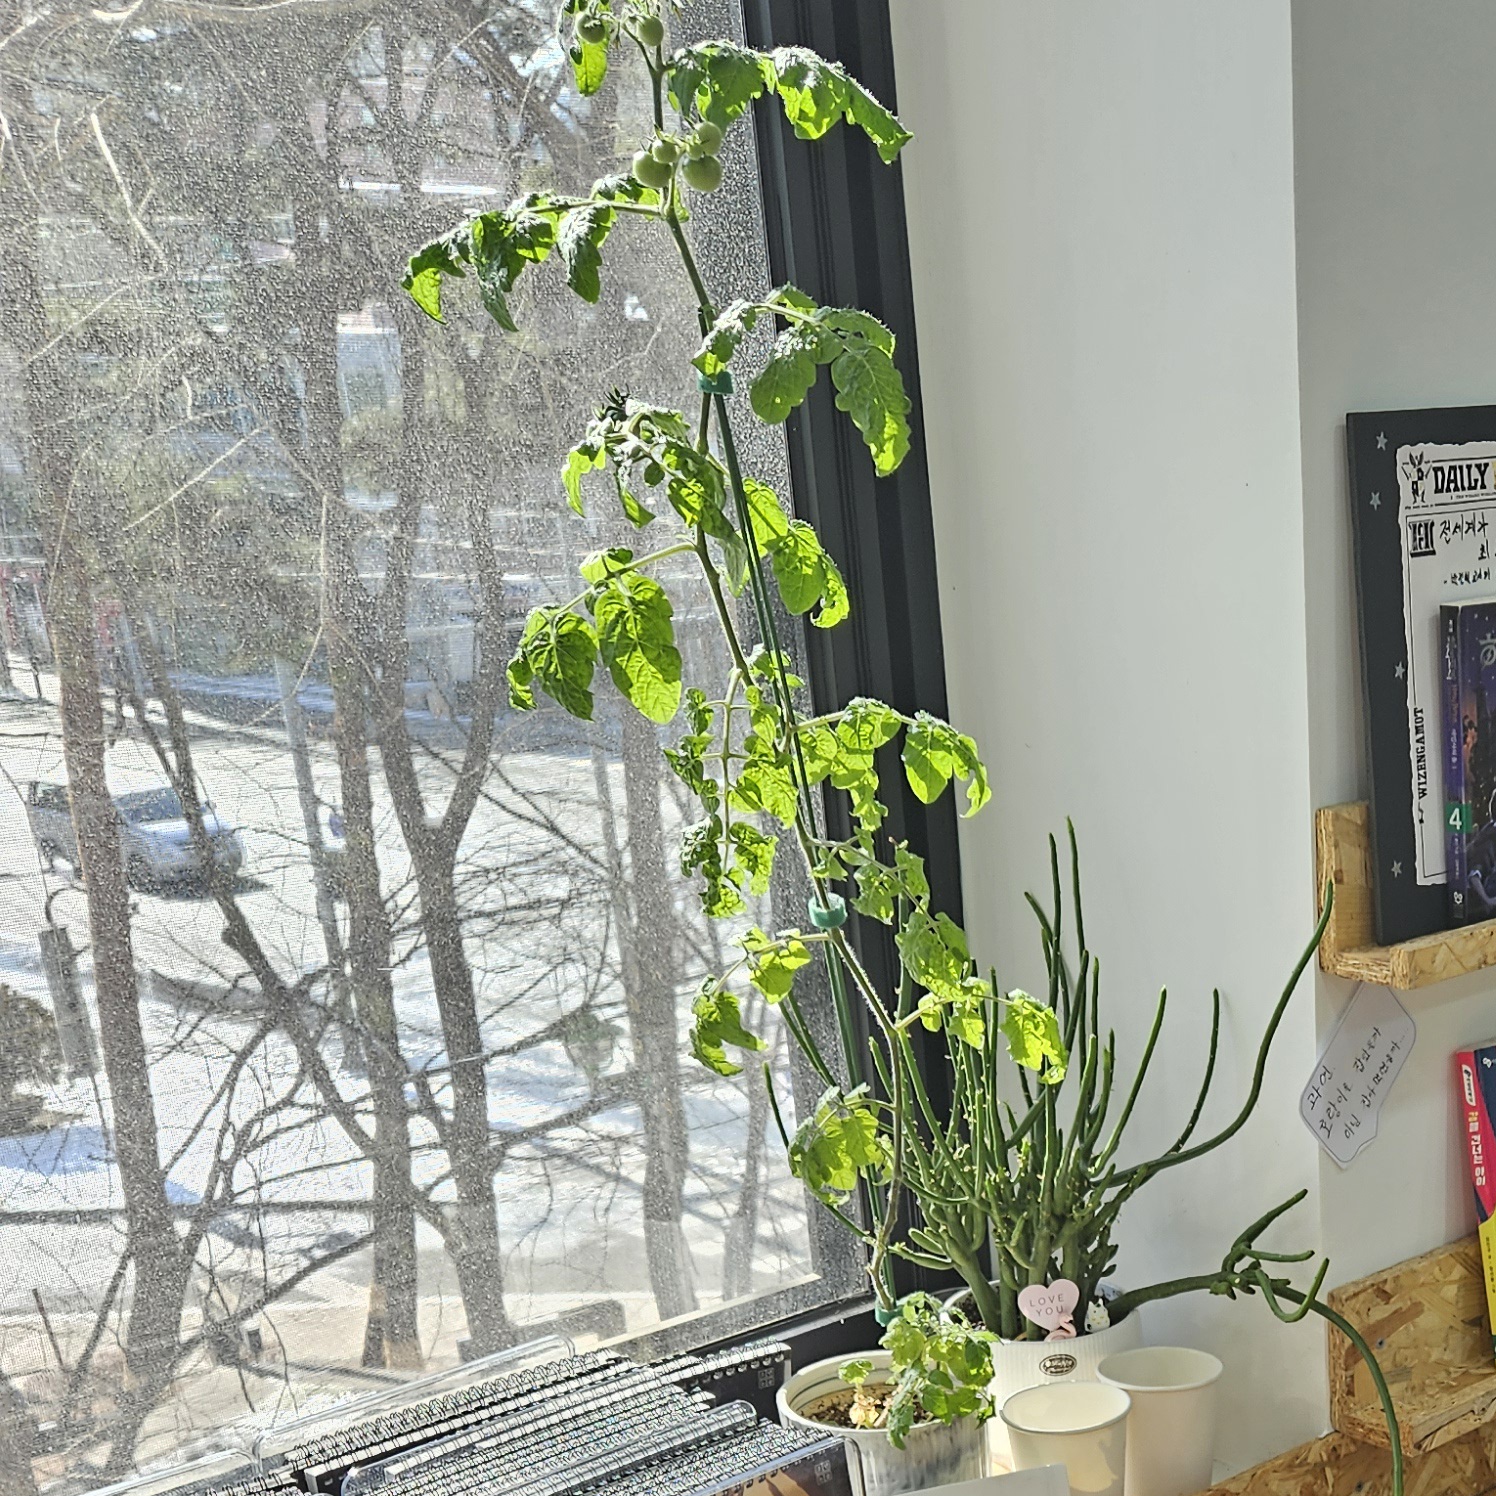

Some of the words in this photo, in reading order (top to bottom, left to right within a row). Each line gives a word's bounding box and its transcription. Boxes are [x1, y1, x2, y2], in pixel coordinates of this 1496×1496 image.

[1432, 462, 1489, 494] DAILY
[1440, 511, 1488, 545] 전세계가
[1413, 707, 1428, 800] WIZENGAMOT
[1449, 808, 1463, 830] 4
[1471, 1135, 1483, 1165] 건너는
[1475, 1166, 1486, 1186] 아이
[1029, 1293, 1065, 1308] LOVE
[1035, 1305, 1065, 1318] YOU
